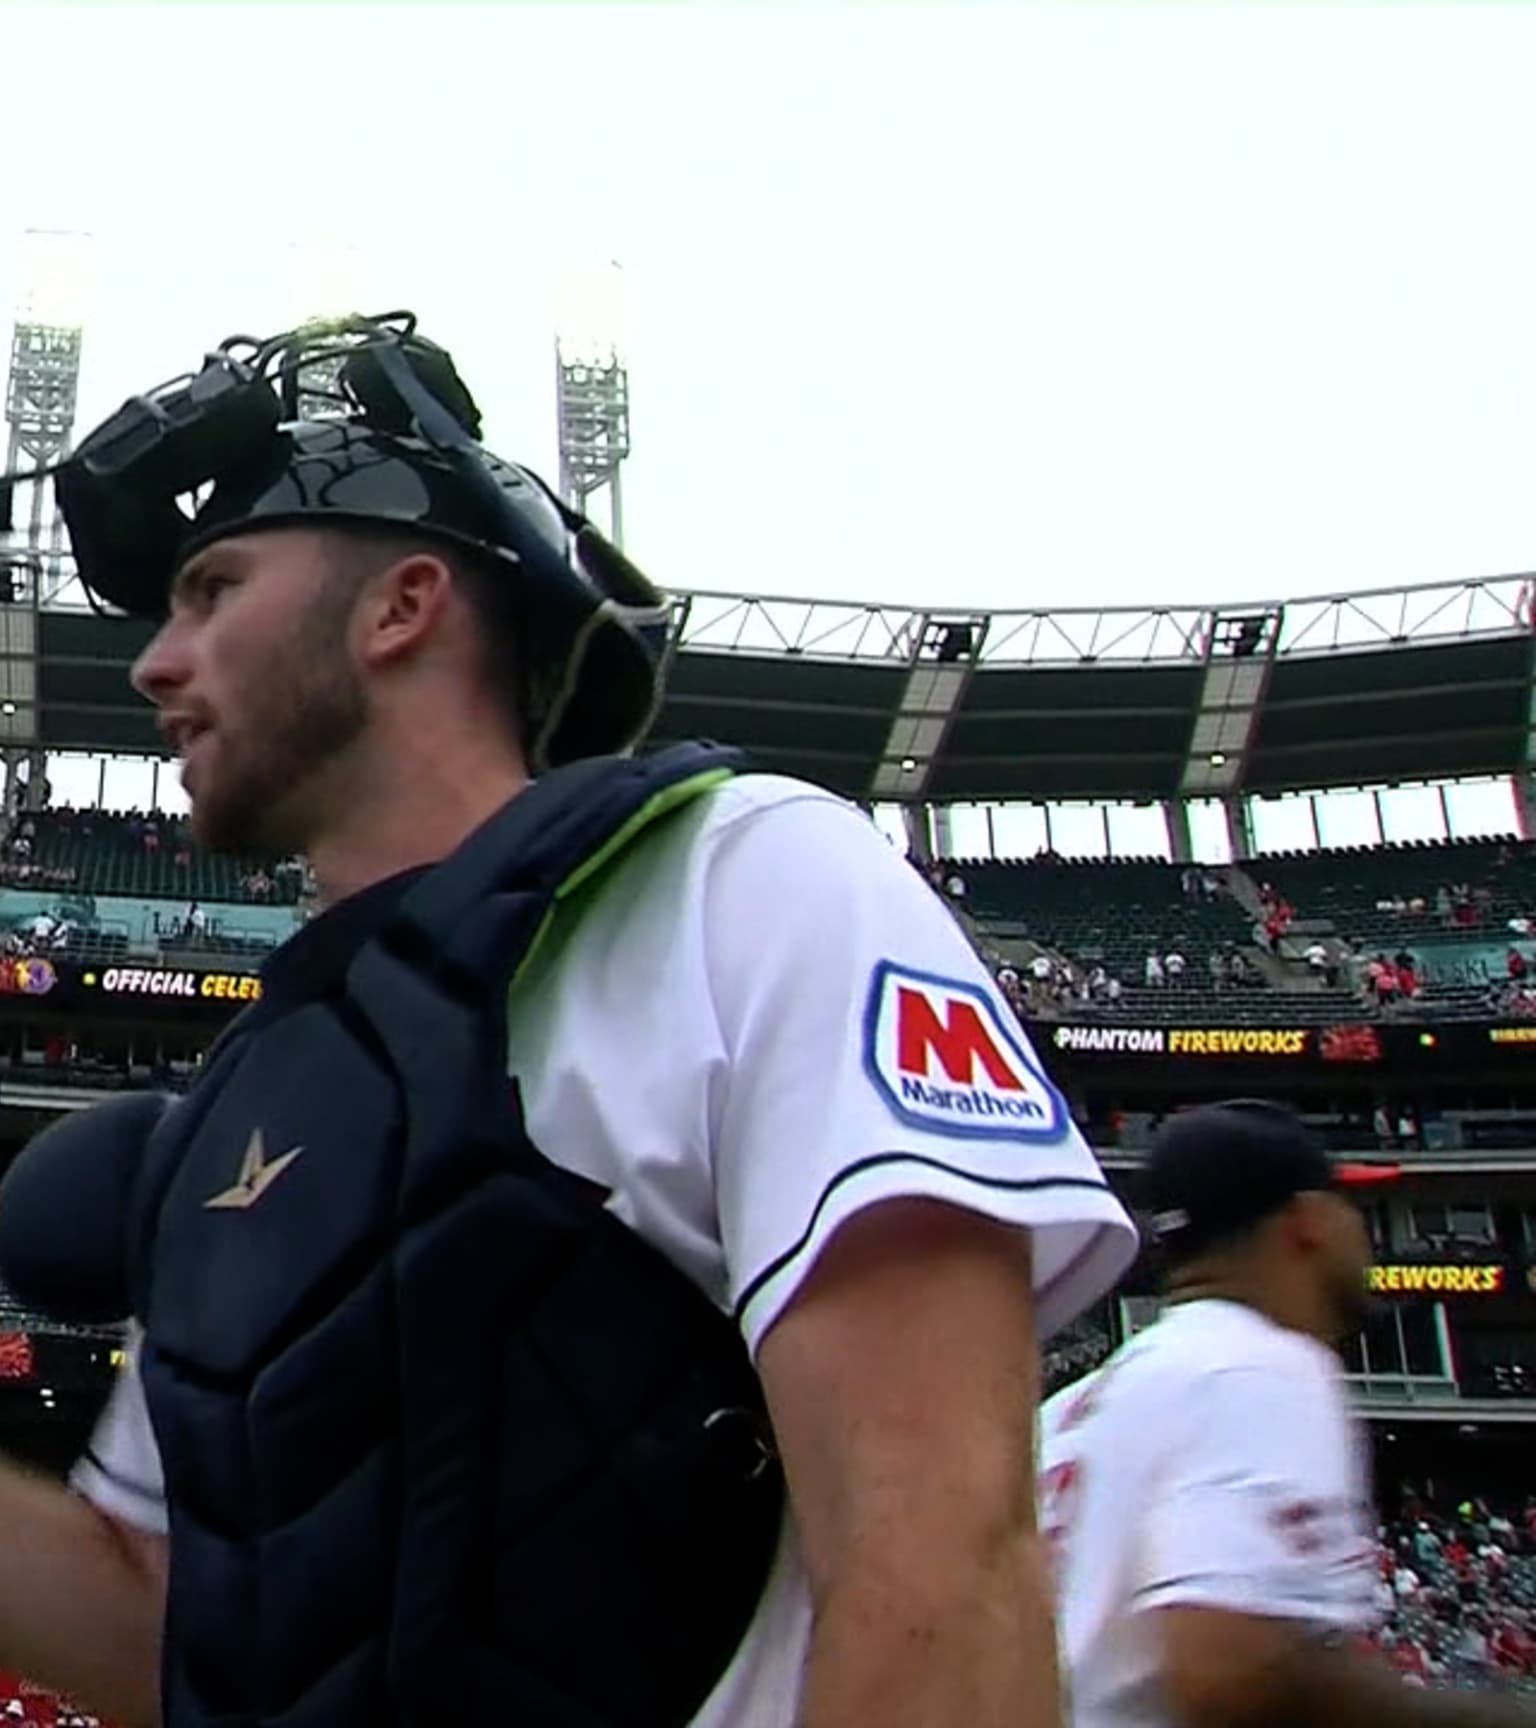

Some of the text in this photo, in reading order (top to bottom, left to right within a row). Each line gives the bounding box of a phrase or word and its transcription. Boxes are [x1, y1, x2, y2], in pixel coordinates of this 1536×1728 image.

[102, 969, 197, 998] OFFICIAL
[1055, 1026, 1305, 1055] PHANTOM FIREWORKS
[899, 1075, 1045, 1120] Marathon
